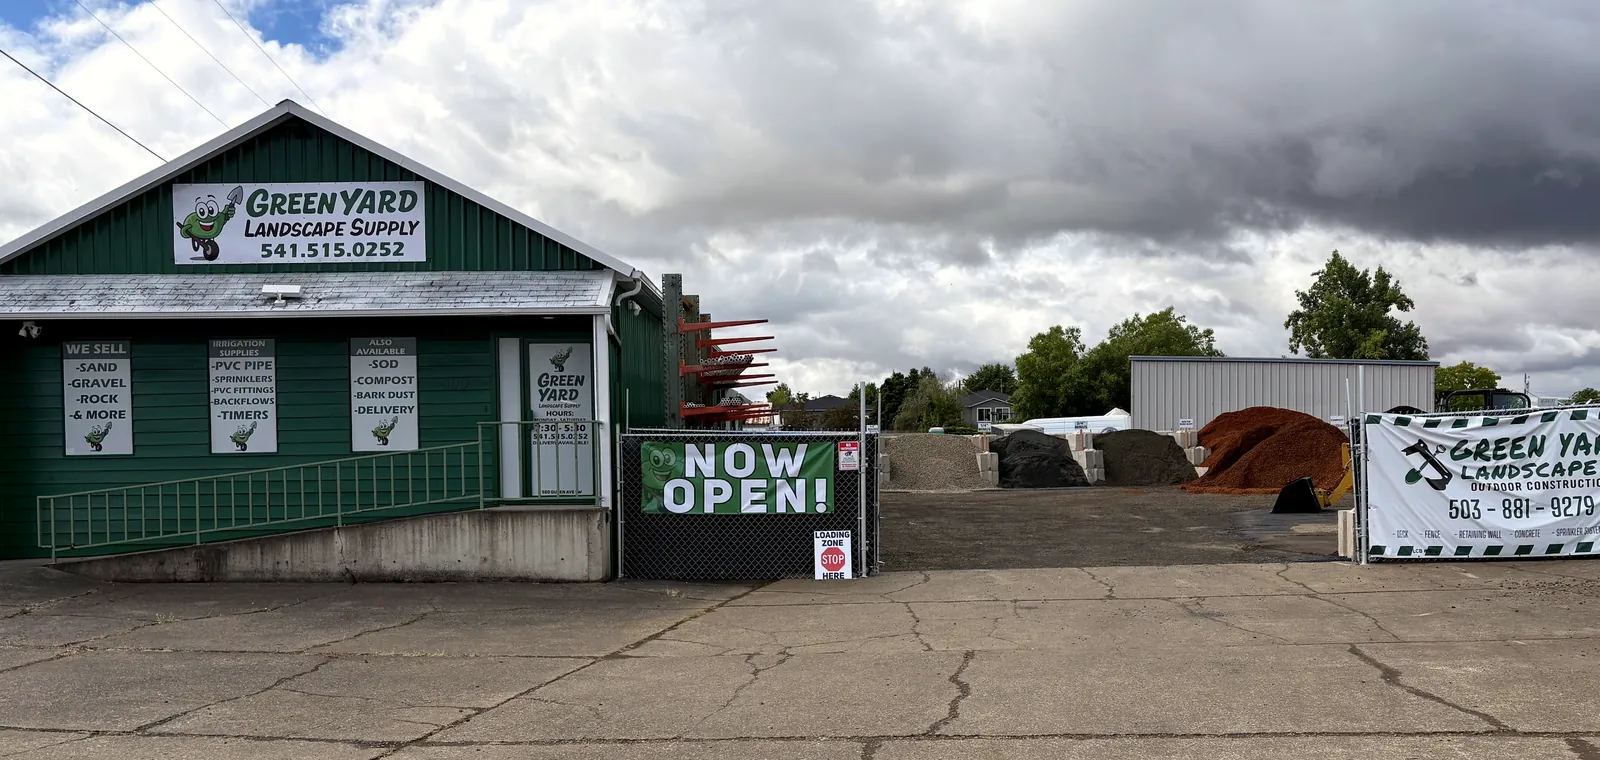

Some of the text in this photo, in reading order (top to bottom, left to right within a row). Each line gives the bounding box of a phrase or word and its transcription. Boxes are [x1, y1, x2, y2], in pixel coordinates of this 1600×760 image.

[244, 218, 420, 238] LANDSCAPE SUPPLY
[261, 242, 405, 258] 541.515.0252
[66, 344, 126, 354] WE SELL
[76, 363, 117, 372] -SAND
[211, 361, 272, 370] -PVC PIPE
[368, 360, 398, 368] -SOD
[68, 378, 126, 388] -GRAVEL
[354, 376, 414, 385] -COMPOST
[537, 372, 585, 388] GREEN
[76, 394, 118, 403] -ROCK
[538, 388, 579, 402] YARD
[86, 410, 126, 419] MORE
[217, 410, 269, 420] -TIMERS
[354, 406, 415, 414] -DELIVERY
[1450, 434, 1546, 462] GREEN
[684, 442, 809, 478] NOW
[1460, 460, 1597, 480] LANDSCAPE
[1471, 482, 1522, 492] OUTDOOR
[663, 478, 828, 514] OPEN!
[1449, 499, 1481, 520] 503
[1502, 498, 1530, 519] 881
[1551, 495, 1595, 517] 9279
[1425, 530, 1440, 538] FENCE
[1459, 530, 1486, 539] RETAINING
[1488, 530, 1502, 538] WALL
[1514, 529, 1540, 538] CONCRETE
[1556, 527, 1583, 536] SPRINKLER
[1584, 526, 1600, 535] SYSTE
[822, 554, 844, 565] STOP
